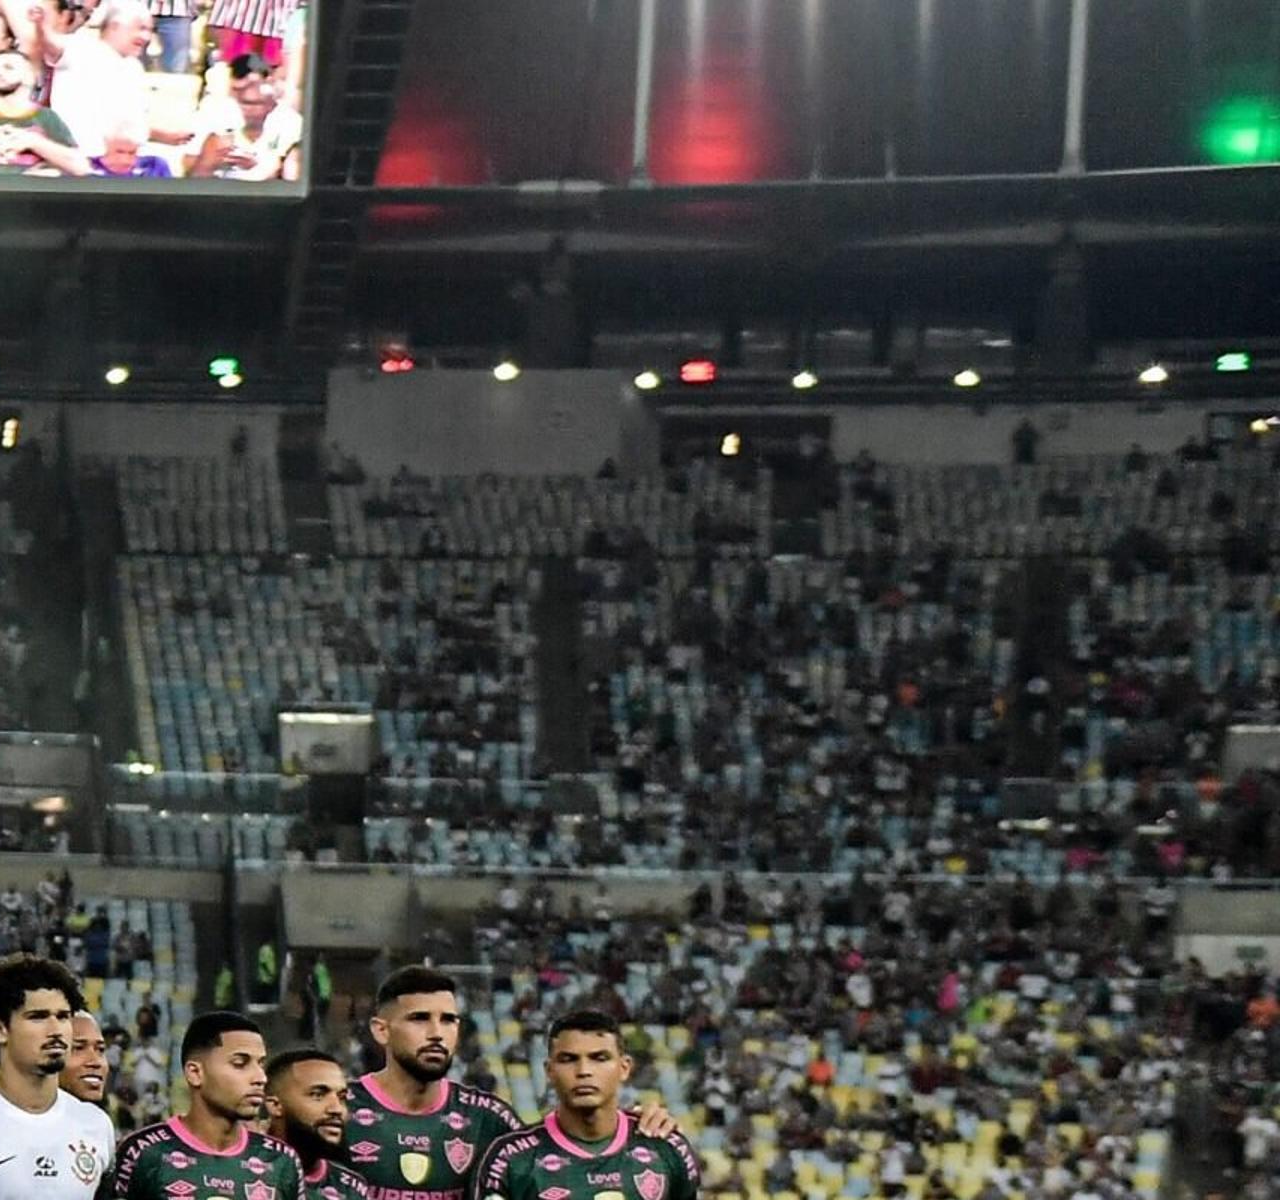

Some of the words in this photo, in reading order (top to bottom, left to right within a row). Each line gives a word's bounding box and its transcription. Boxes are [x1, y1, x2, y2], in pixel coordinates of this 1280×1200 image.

[459, 1091, 522, 1131] ZINZAN
[397, 1133, 431, 1147] Leve
[115, 1127, 171, 1193] ZINZANE
[485, 1133, 540, 1190] ZINZANE
[203, 1175, 235, 1190] Leve
[587, 1171, 622, 1185] Leve
